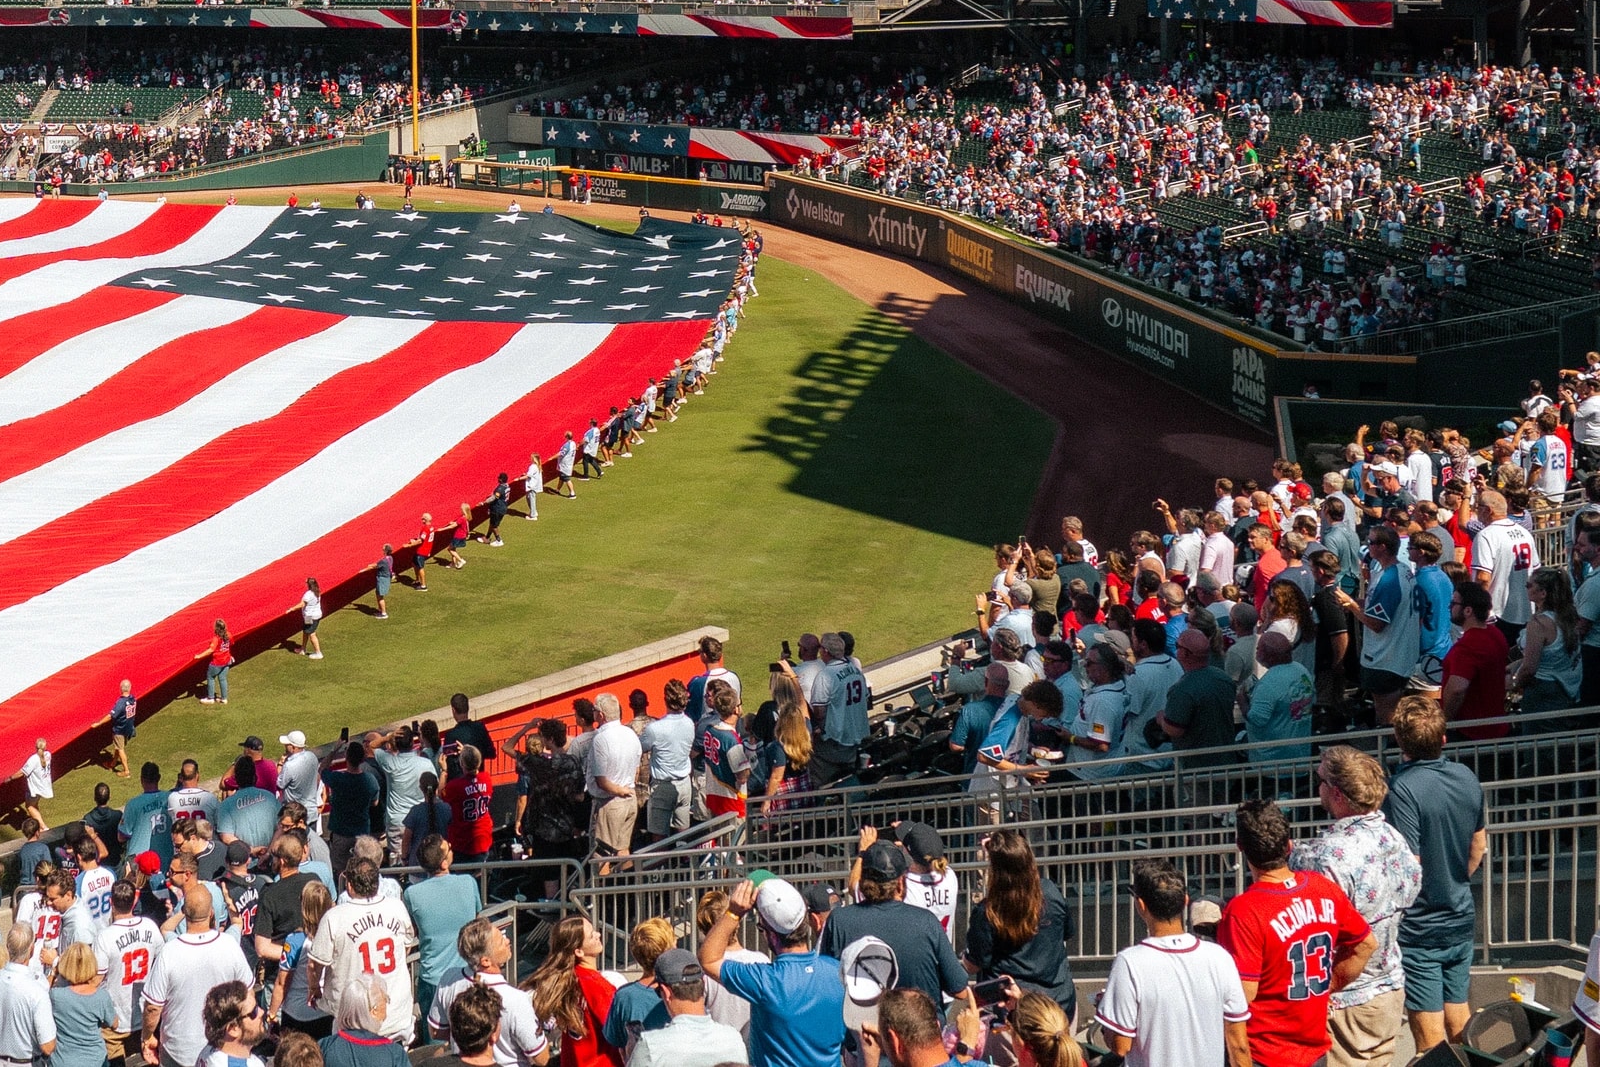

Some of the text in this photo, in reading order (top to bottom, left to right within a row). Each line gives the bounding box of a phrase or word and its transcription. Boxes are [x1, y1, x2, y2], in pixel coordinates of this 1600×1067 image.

[629, 154, 670, 173] MLB+
[590, 178, 618, 188] SOUTH
[590, 187, 627, 198] COLLEGE
[731, 193, 760, 205] ARROW
[802, 198, 845, 227] Wellstar
[868, 207, 927, 257] xfinity
[947, 228, 993, 272] QUIKRETE
[1015, 264, 1072, 312] EQUIFAX
[1126, 308, 1189, 358] HYUNDAI
[1232, 347, 1265, 383] PAPA
[1232, 373, 1266, 405] JOHNS
[179, 797, 201, 807] OLSON
[87, 876, 110, 892] OLSON
[924, 890, 949, 908] SALE
[35, 914, 62, 939] 13
[347, 911, 383, 943] ACUÑA
[1270, 897, 1317, 942] ACUÑA
[122, 948, 149, 986] 13
[359, 937, 396, 975] 13
[1287, 931, 1333, 1001] 13
